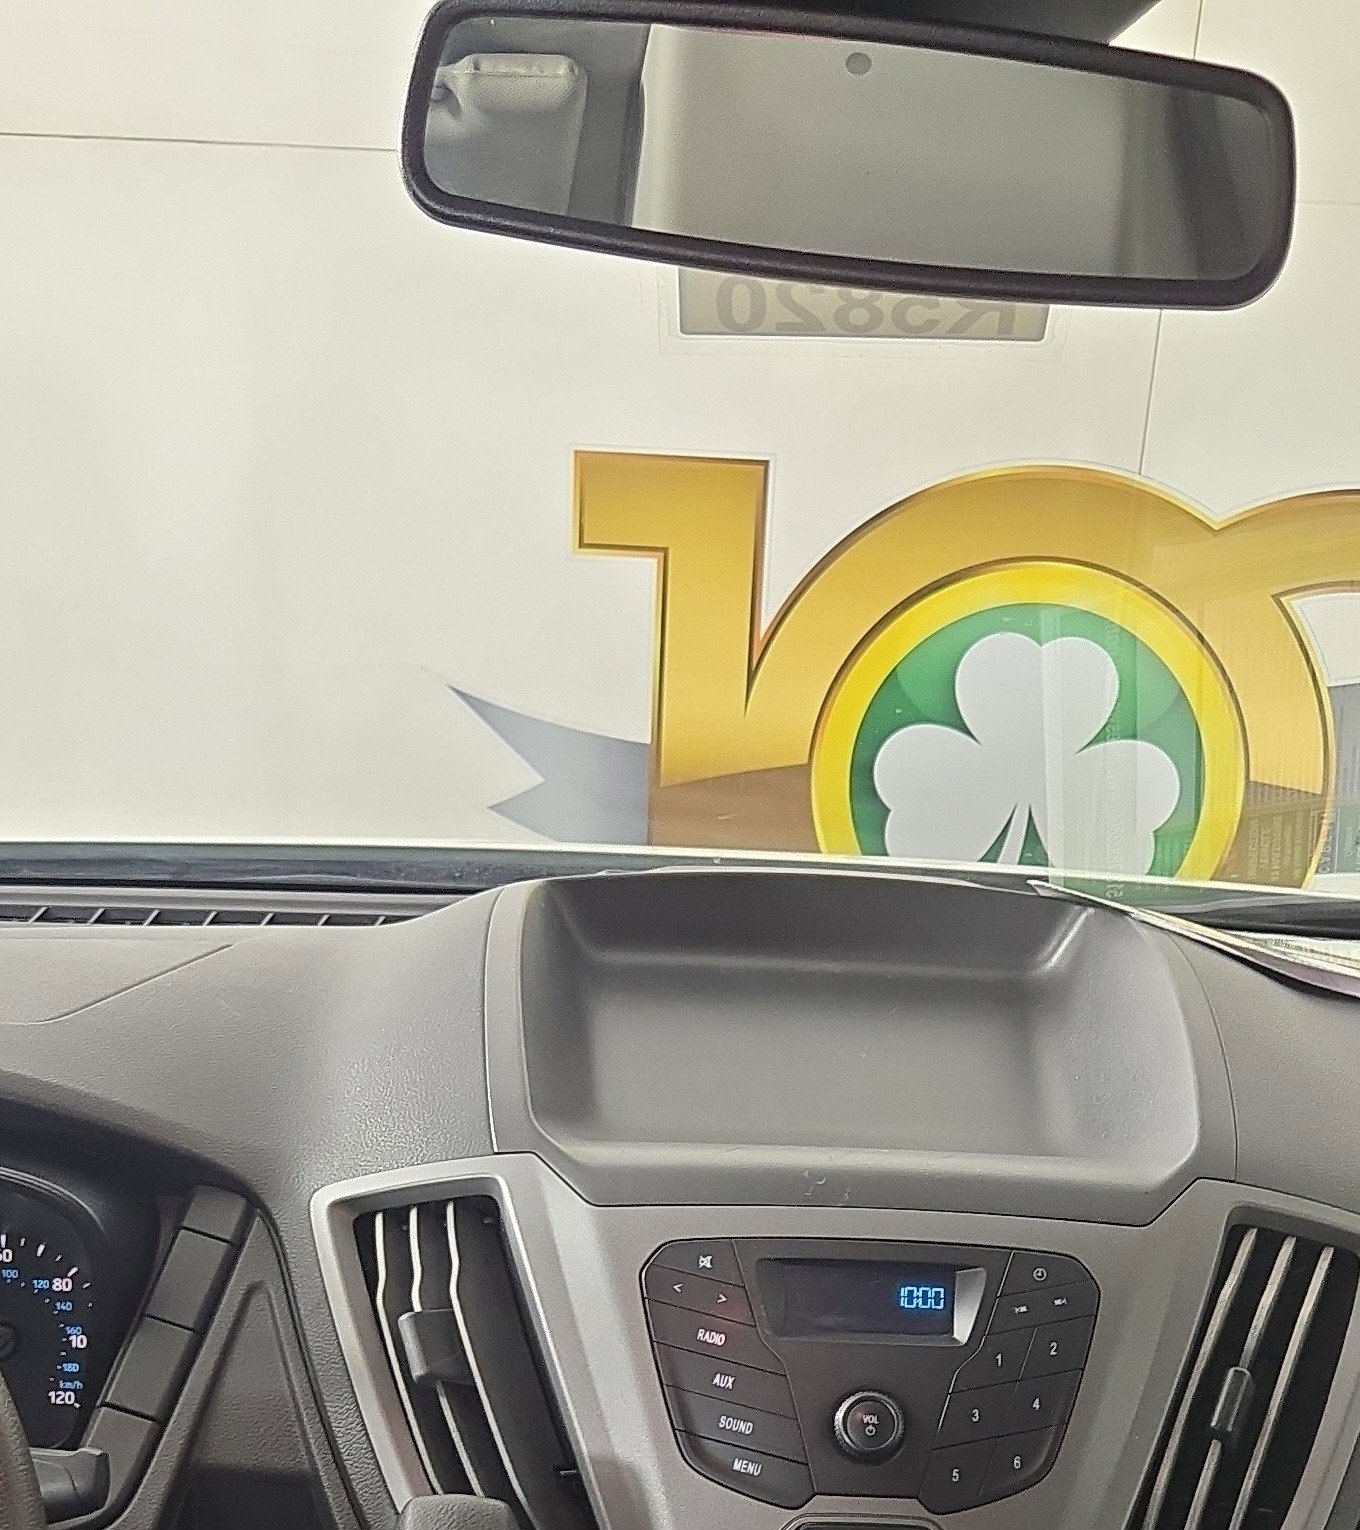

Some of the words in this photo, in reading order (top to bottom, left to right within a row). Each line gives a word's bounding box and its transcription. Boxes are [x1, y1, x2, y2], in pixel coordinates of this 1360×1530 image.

[52, 1277, 73, 1292] 80
[696, 1327, 726, 1347] RADIO
[1049, 1341, 1058, 1356] 2
[995, 1353, 1003, 1366] 1
[712, 1373, 735, 1390] AUX
[48, 1391, 75, 1405] 120
[1032, 1397, 1041, 1410] 4
[862, 1414, 880, 1425] VOL
[971, 1408, 980, 1422] 3
[719, 1415, 754, 1436] SOUND
[732, 1457, 762, 1476] MENU
[1012, 1456, 1021, 1470] 6
[952, 1468, 960, 1483] 5
